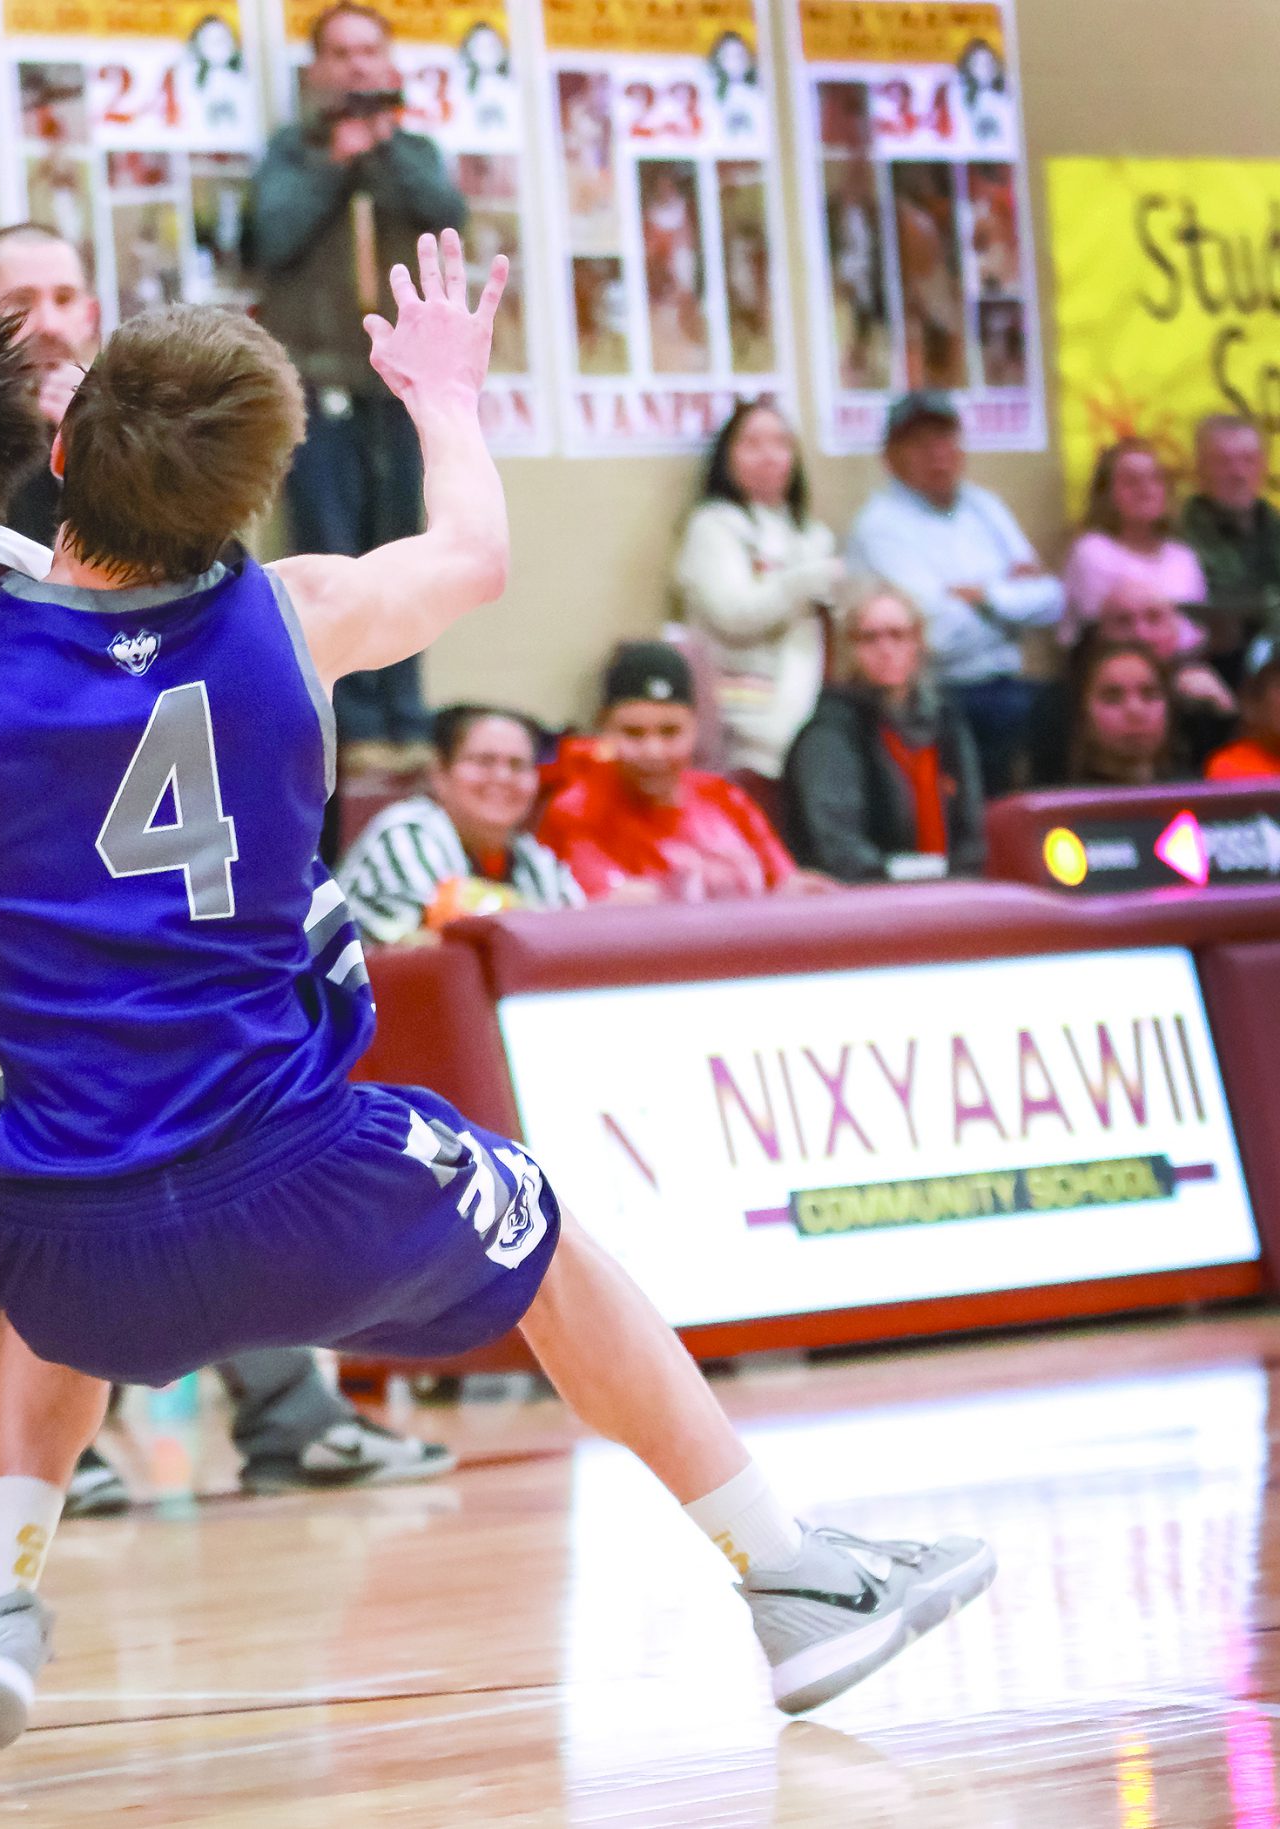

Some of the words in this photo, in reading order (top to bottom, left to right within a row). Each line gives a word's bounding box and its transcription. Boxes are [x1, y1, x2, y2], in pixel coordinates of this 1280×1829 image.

[97, 63, 185, 127] 24
[623, 82, 703, 139] 23
[873, 81, 955, 139] 34
[95, 680, 239, 921] 4
[707, 1013, 1204, 1168] NIXYAAWII
[794, 1170, 1018, 1234] COMMUNITY
[1024, 1156, 1163, 1211] SCHOOL
